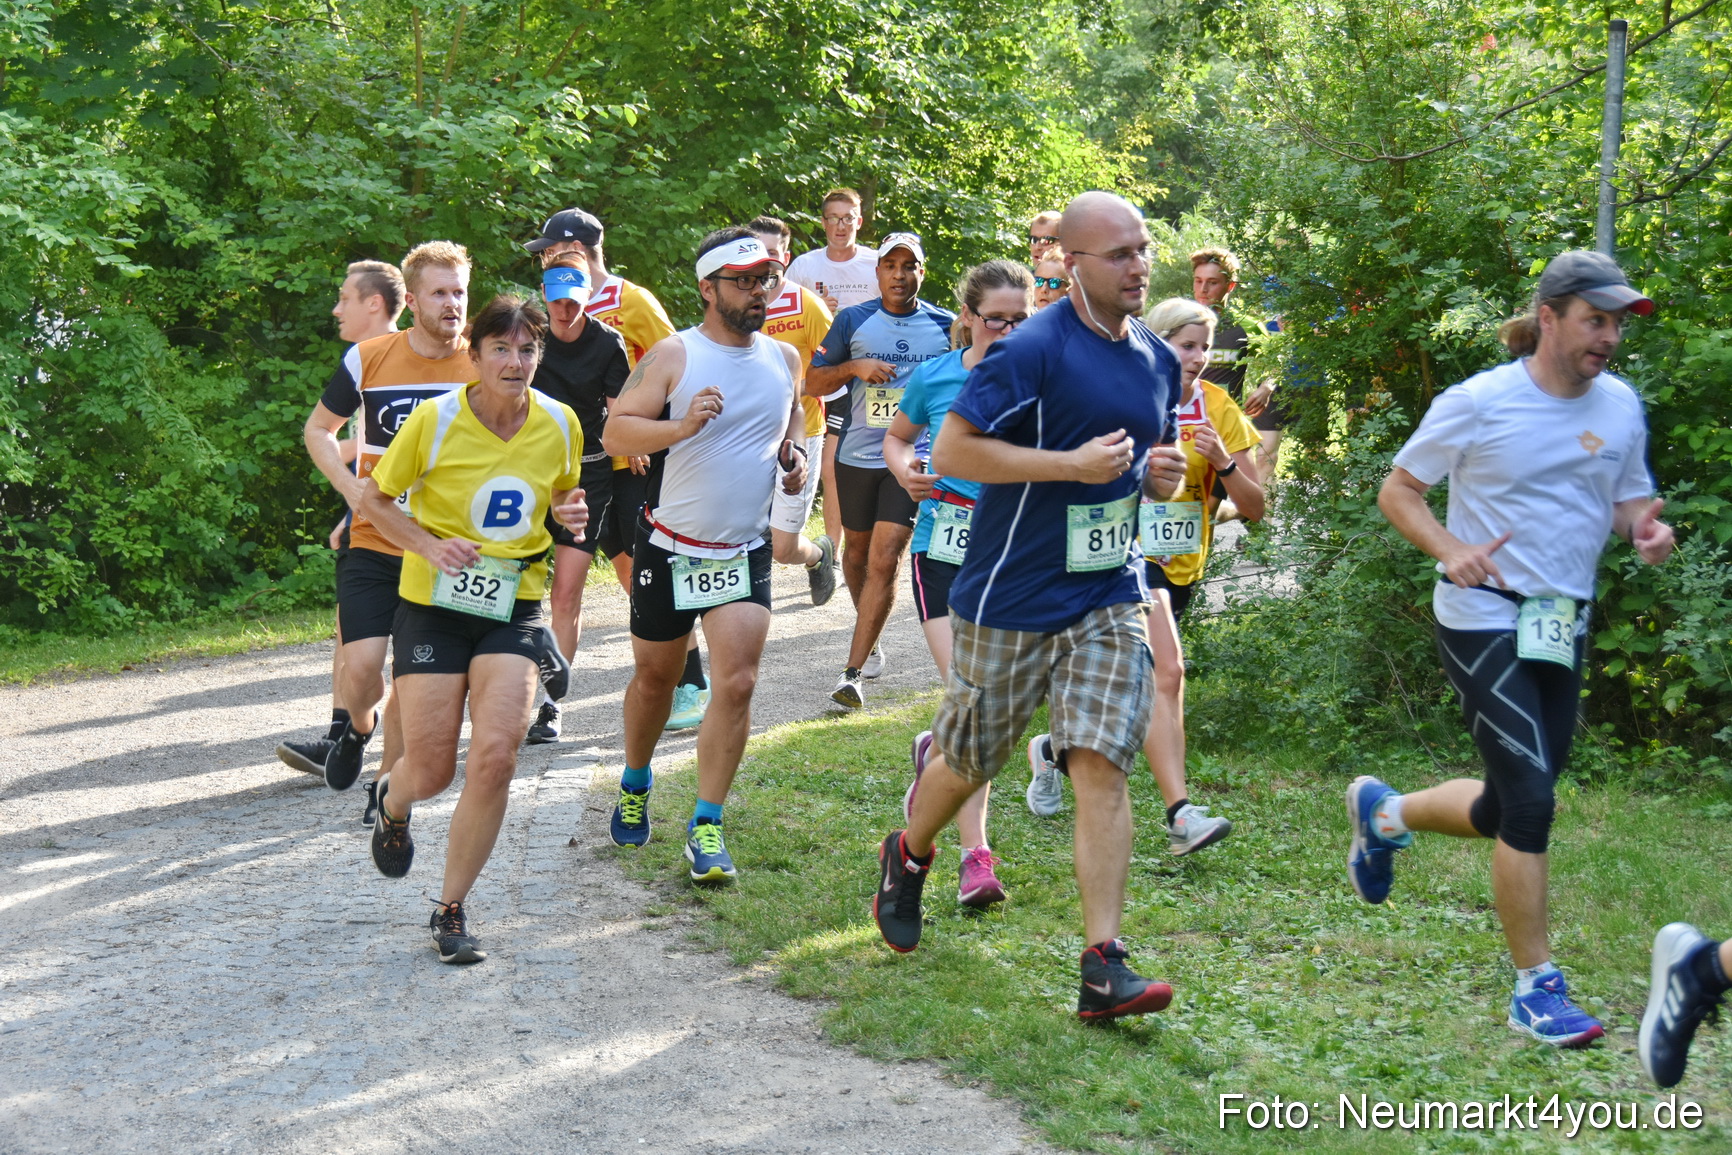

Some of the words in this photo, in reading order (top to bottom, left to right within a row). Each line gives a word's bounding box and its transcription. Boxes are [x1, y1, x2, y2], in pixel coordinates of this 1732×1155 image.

[767, 319, 805, 336] BÖGL
[482, 490, 524, 528] B
[1088, 522, 1129, 552] 810
[1149, 521, 1195, 541] 1670
[453, 571, 501, 601] 352
[684, 569, 740, 594] 1855
[451, 592, 483, 604] Miesbauer
[484, 600, 497, 608] Elke
